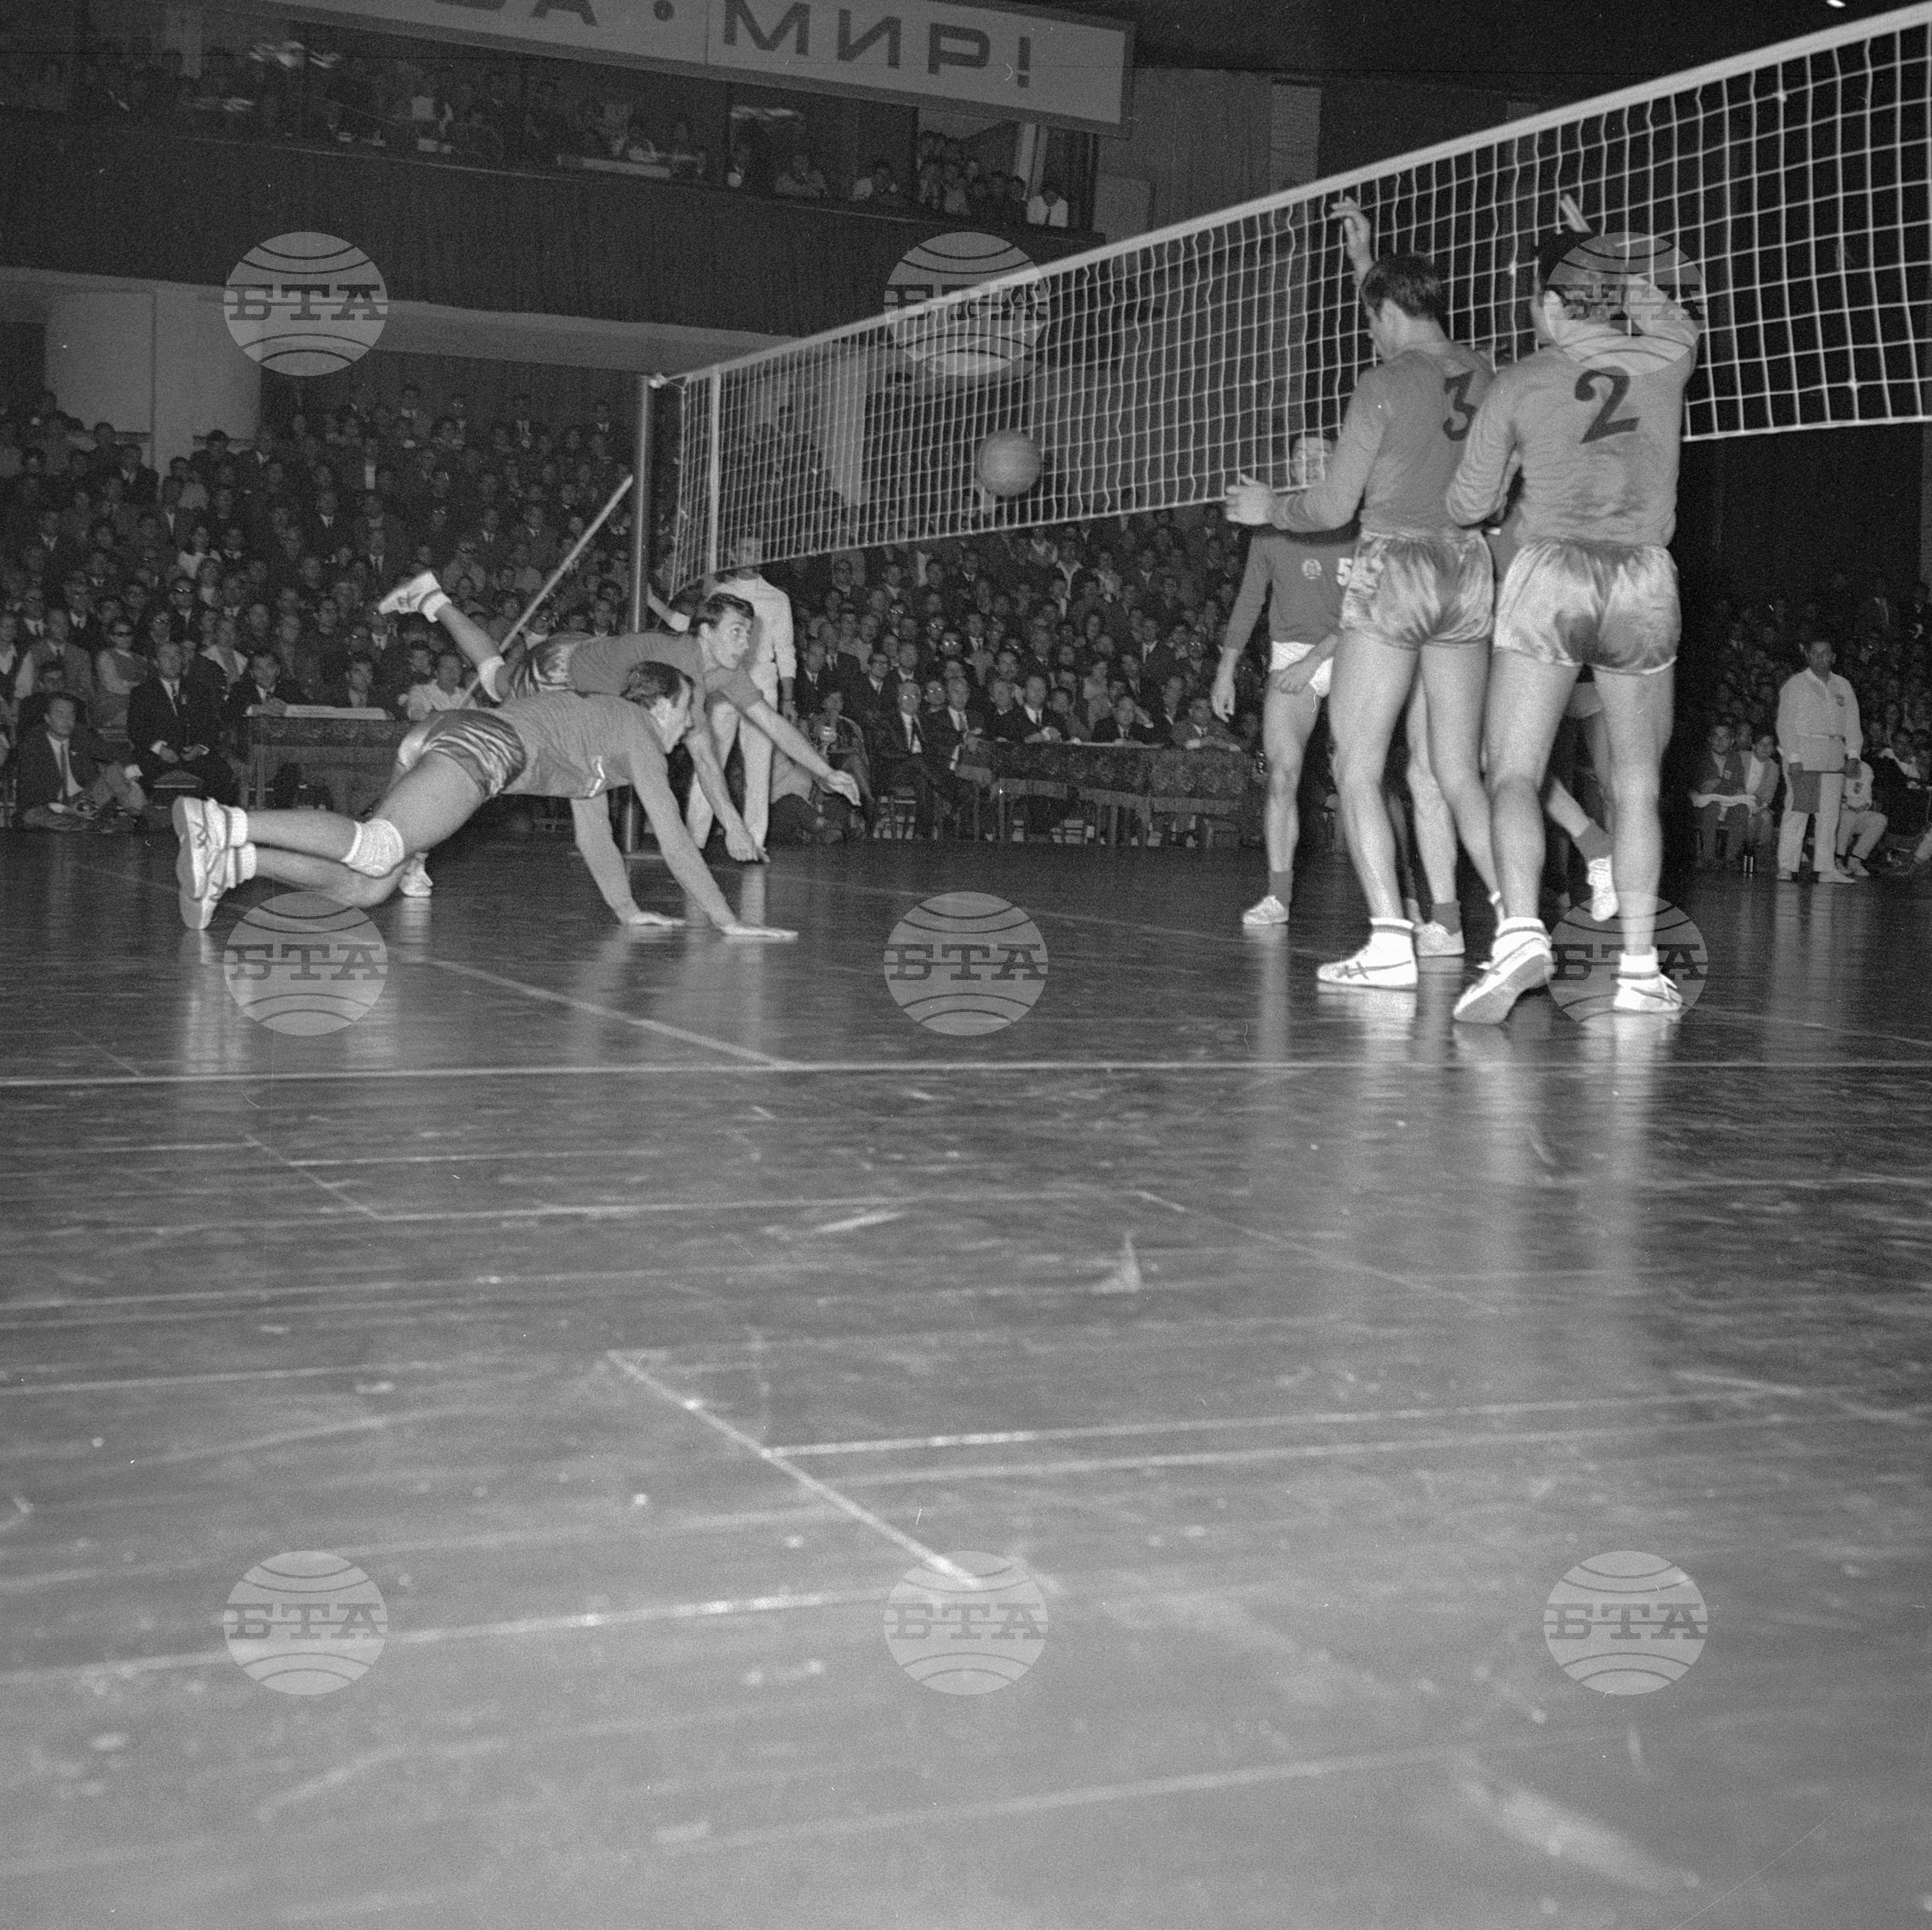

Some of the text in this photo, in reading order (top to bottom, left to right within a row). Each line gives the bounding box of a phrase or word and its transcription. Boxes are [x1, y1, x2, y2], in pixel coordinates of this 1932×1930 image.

[724, 0, 1031, 88] МИР!
[1443, 370, 1478, 442] 3
[1575, 365, 1641, 444] 2
[1336, 557, 1353, 586] 5
